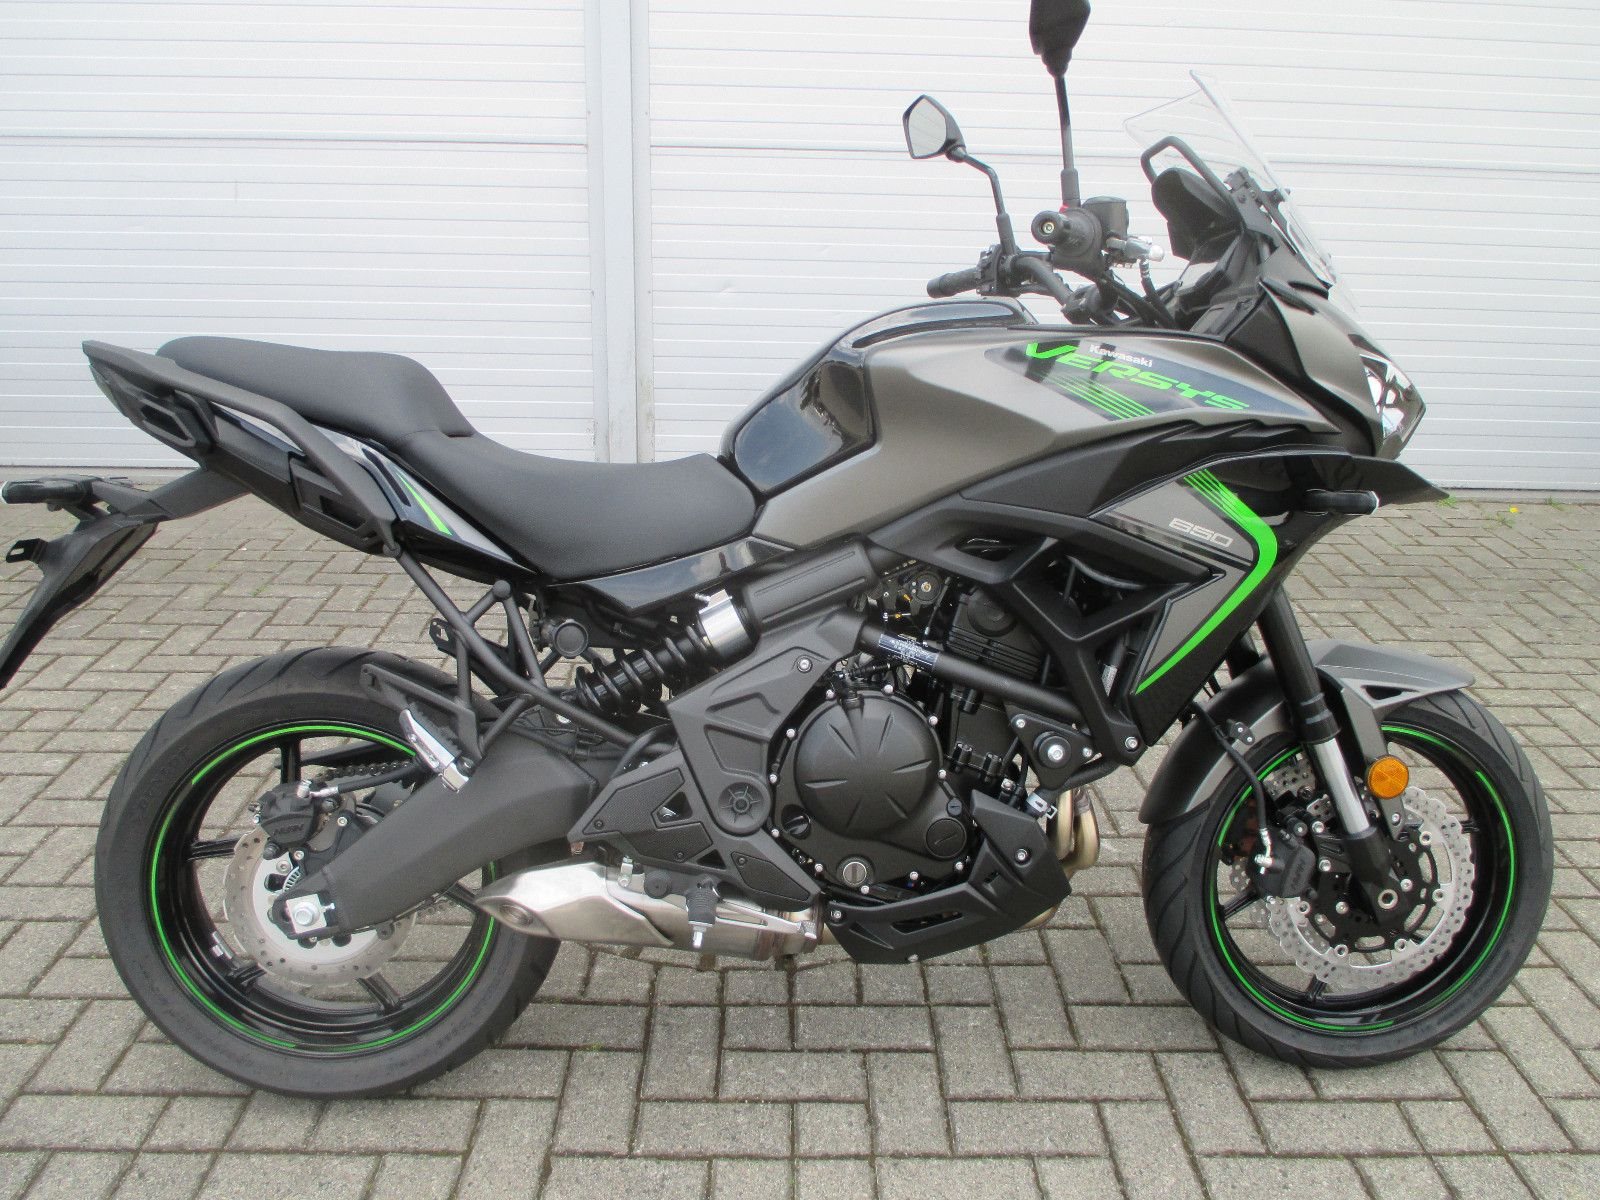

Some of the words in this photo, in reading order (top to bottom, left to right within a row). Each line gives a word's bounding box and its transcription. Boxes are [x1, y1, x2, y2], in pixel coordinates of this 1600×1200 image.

[1089, 344, 1153, 368] Kawasaki
[1025, 342, 1250, 410] VERSYS
[1168, 517, 1233, 547] 650
